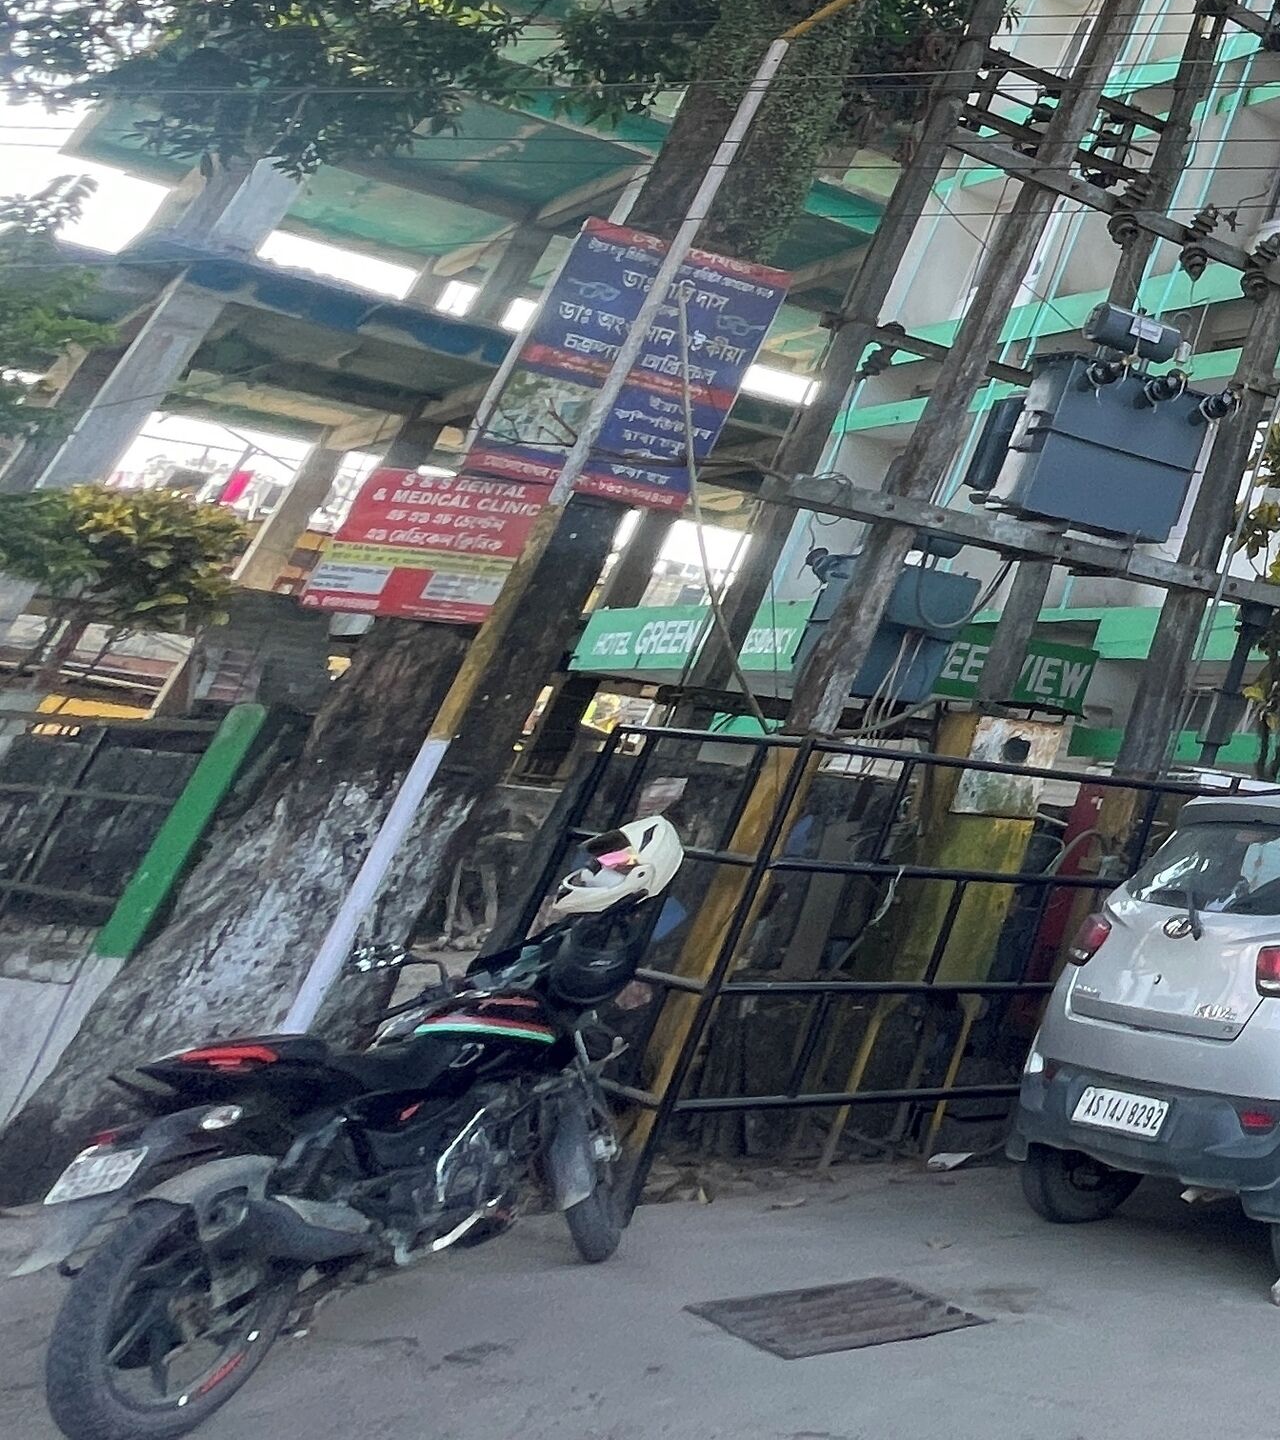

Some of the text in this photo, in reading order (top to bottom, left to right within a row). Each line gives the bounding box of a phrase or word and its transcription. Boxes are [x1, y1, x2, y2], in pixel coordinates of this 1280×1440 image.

[453, 477, 526, 499] DENTAL
[372, 488, 542, 517] & MEDICAL CLINIC
[633, 620, 702, 655] GREEN
[740, 628, 797, 654] ESIDENCY
